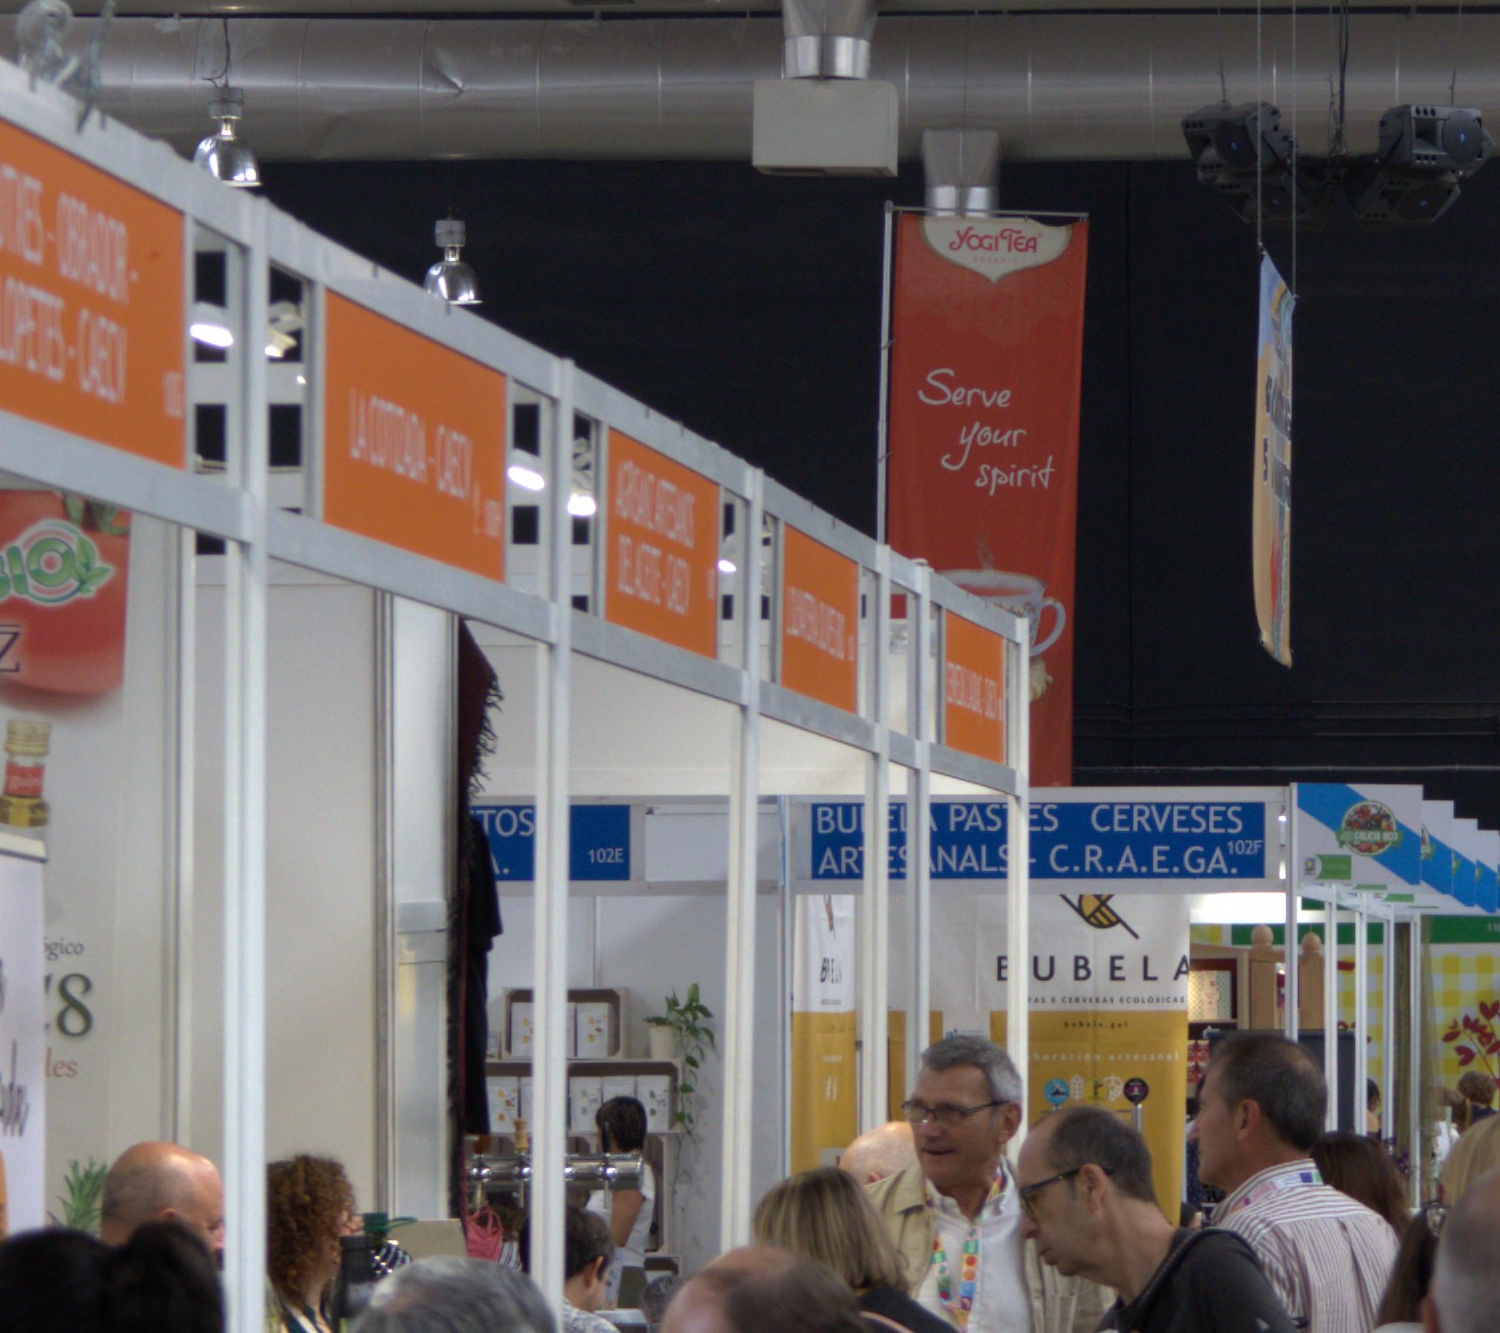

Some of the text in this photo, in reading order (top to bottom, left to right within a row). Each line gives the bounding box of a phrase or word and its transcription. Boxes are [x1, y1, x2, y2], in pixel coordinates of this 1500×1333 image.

[949, 226, 1038, 253] YOGI TEA
[918, 368, 1011, 408] Serve
[941, 421, 1027, 471] your
[975, 455, 1056, 497] spirit
[471, 808, 534, 837] TOS
[950, 804, 1059, 833] PASES
[1091, 804, 1244, 834] CERVESES
[587, 847, 624, 864] 102E
[1227, 839, 1263, 856] 102F
[1031, 1050, 1101, 1062] boración
